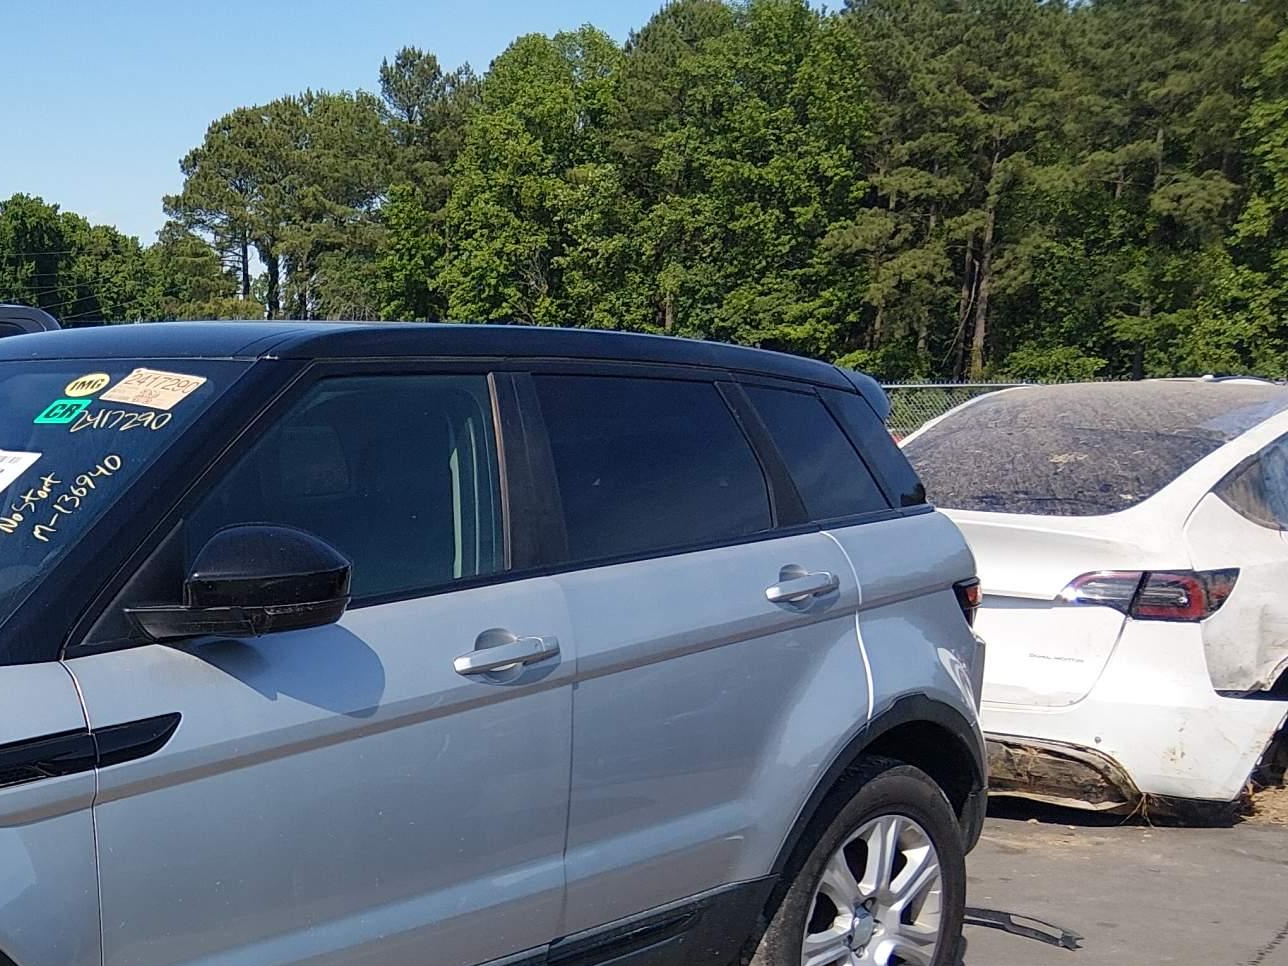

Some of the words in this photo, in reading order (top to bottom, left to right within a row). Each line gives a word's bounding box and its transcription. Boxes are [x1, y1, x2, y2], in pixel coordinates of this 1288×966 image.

[70, 378, 106, 392] IMG
[124, 372, 200, 394] 2417290
[44, 403, 80, 419] CR
[70, 408, 173, 433] 2417290
